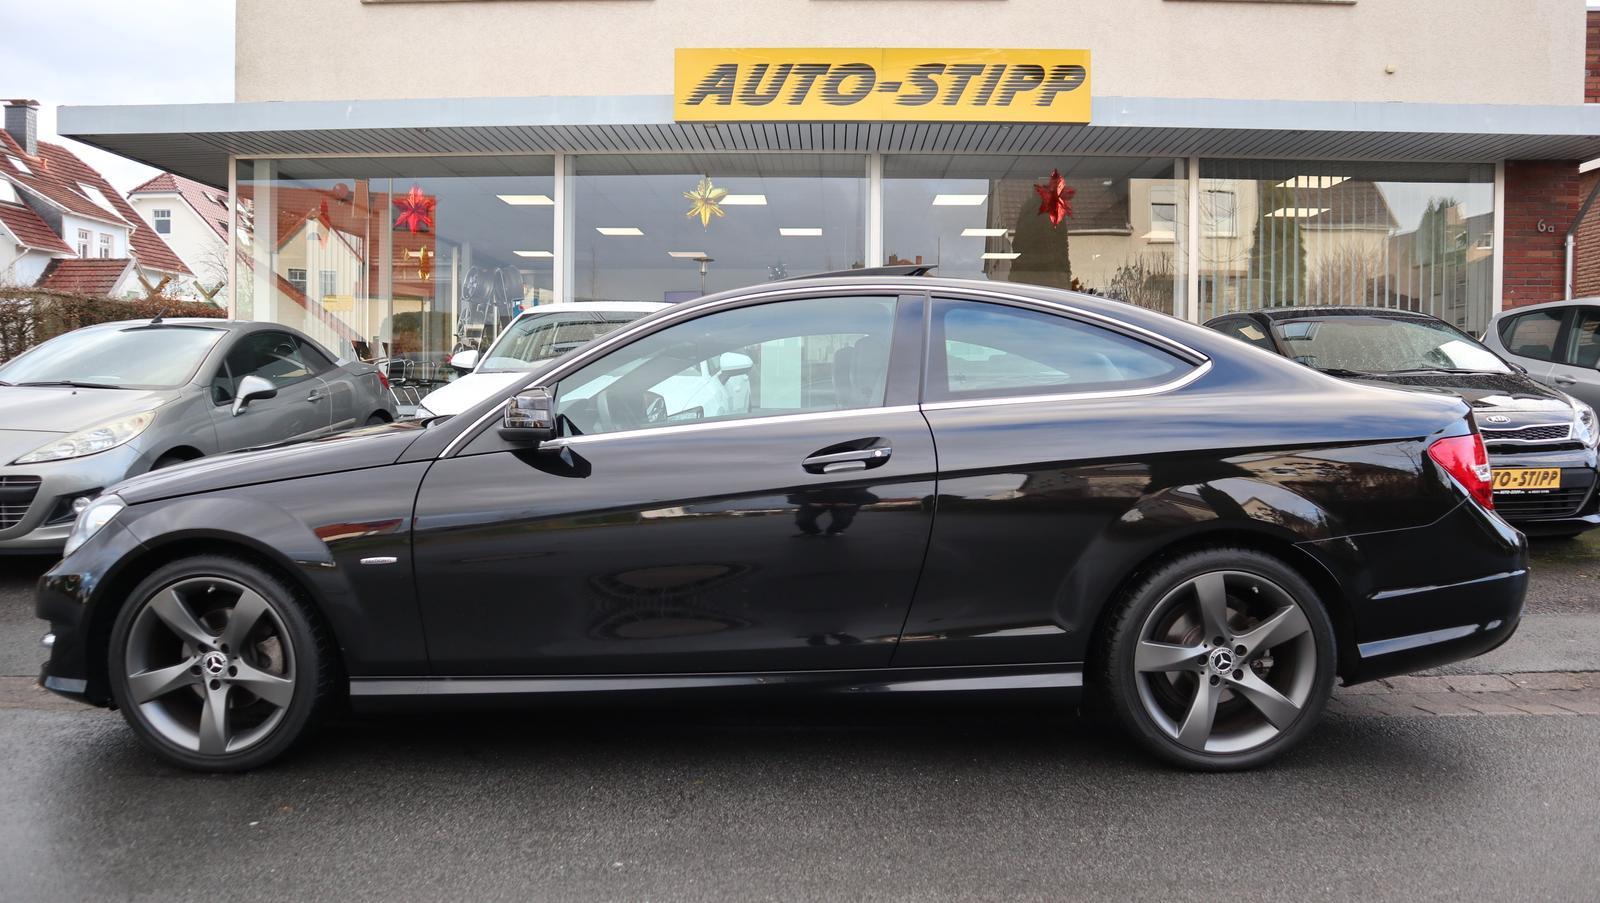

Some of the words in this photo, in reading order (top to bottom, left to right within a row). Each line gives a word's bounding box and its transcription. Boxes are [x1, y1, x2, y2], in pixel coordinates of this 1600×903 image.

[683, 62, 1087, 107] AUTO-STIPP
[1537, 218, 1555, 232] 6a
[1492, 471, 1558, 487] TO-STIPP
